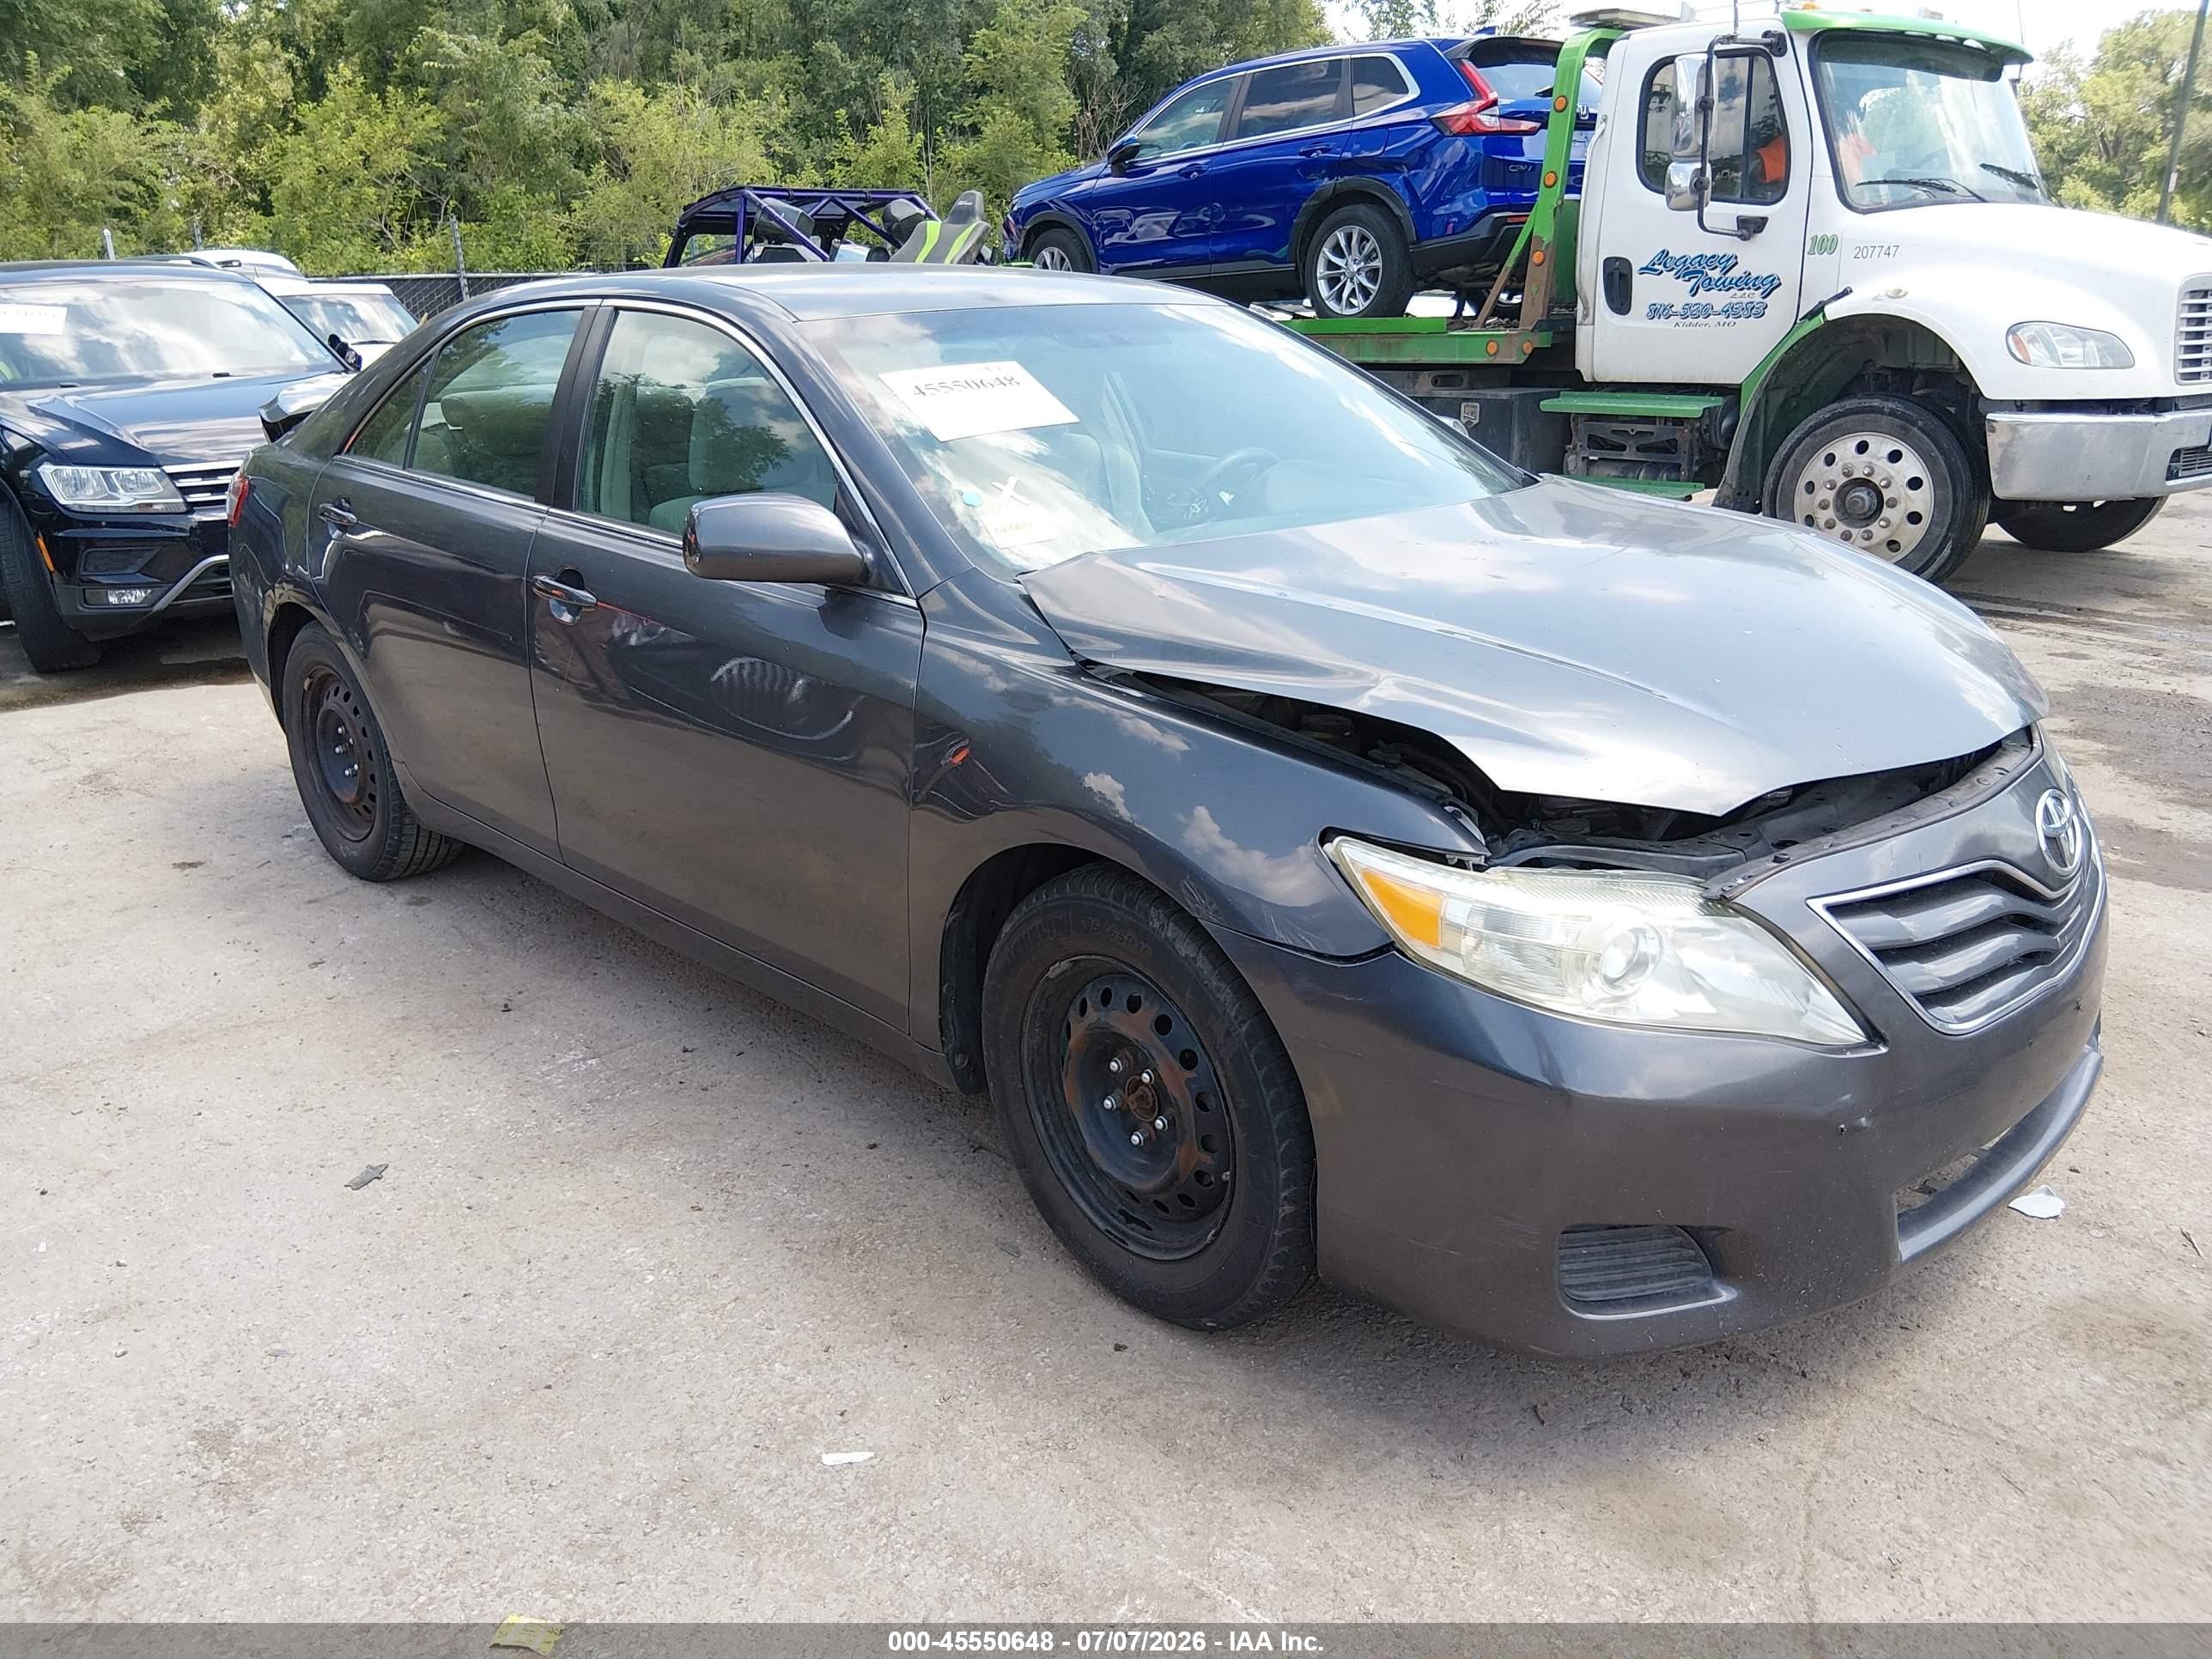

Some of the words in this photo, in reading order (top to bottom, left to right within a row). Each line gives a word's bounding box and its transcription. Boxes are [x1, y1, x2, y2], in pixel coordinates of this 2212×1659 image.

[1807, 234, 1839, 256] 100
[1853, 245, 1900, 259] 207747
[1638, 248, 1739, 280] Legacy
[1680, 270, 1783, 300] Towing
[1646, 301, 1768, 320] 816-520-4383
[912, 375, 1021, 398] 45550648
